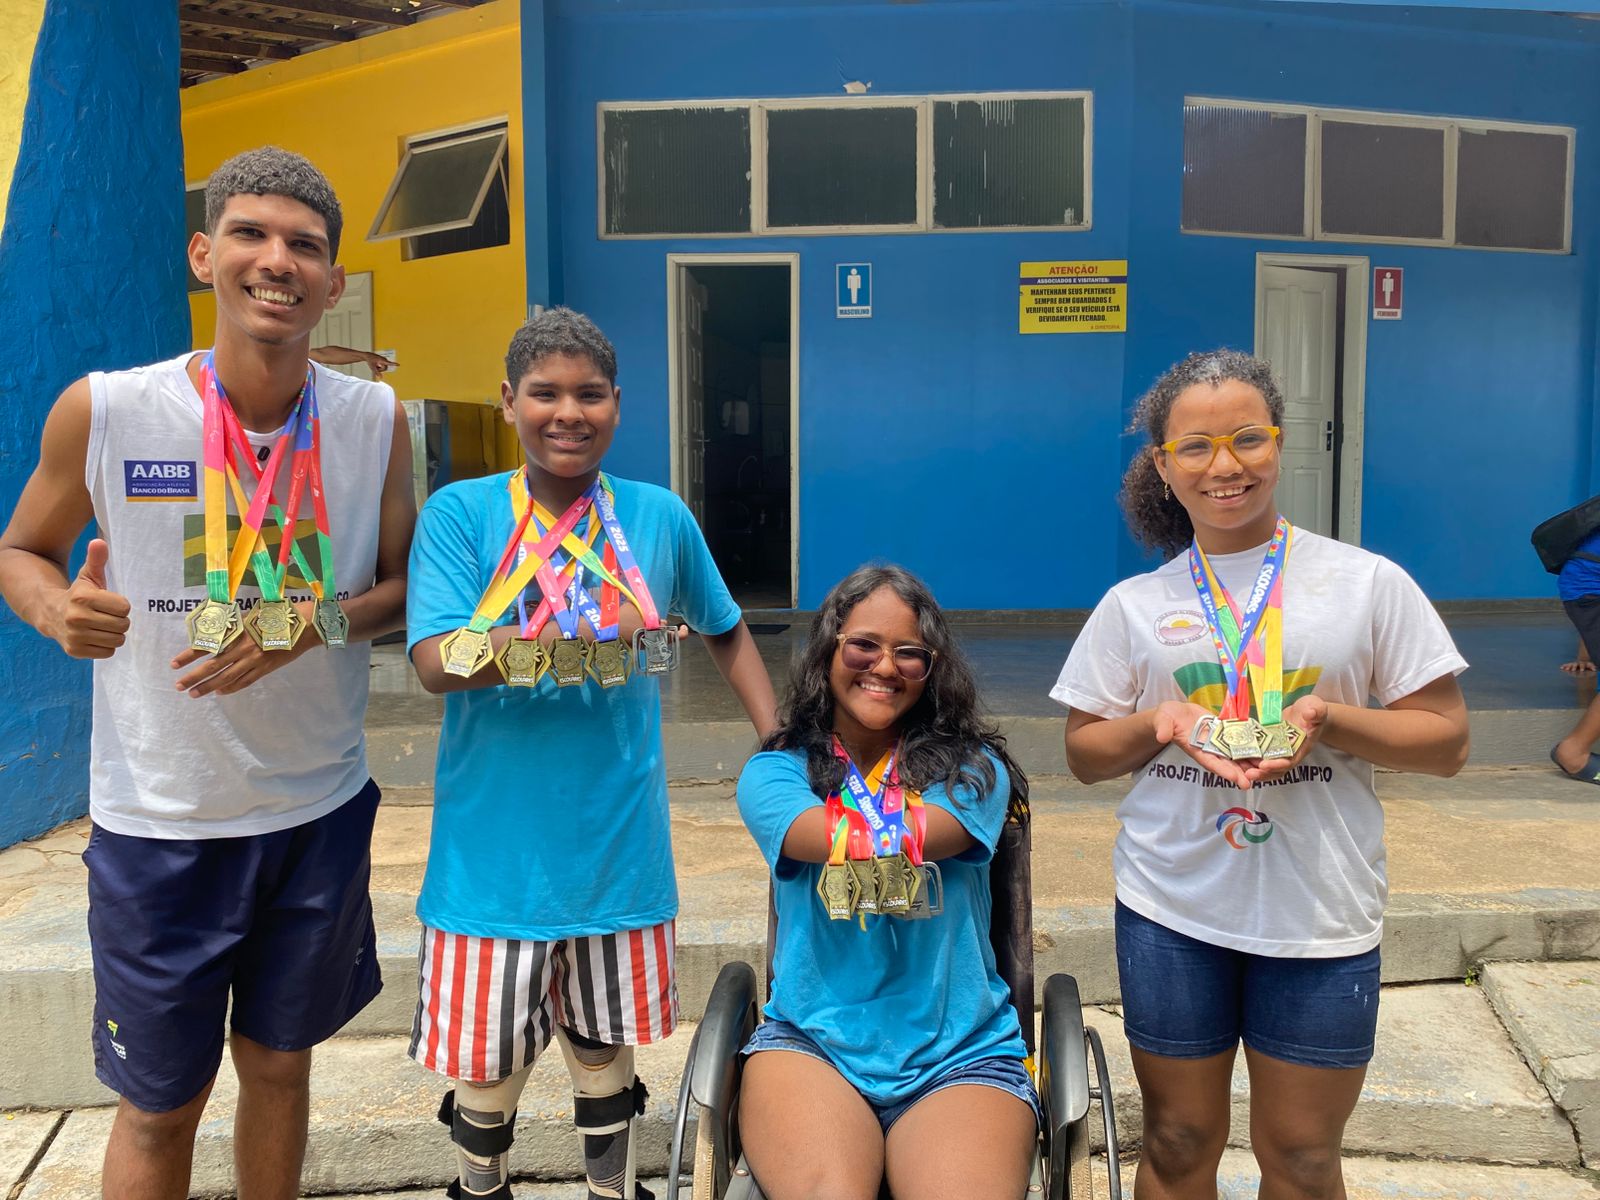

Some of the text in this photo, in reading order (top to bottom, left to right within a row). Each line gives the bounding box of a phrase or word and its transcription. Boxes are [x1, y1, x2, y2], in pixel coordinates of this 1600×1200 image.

[1049, 264, 1098, 276] ATENÇÃO!
[132, 464, 190, 478] AABB
[610, 526, 629, 552] 2025
[148, 600, 205, 612] PROJET
[848, 774, 864, 796] 2025
